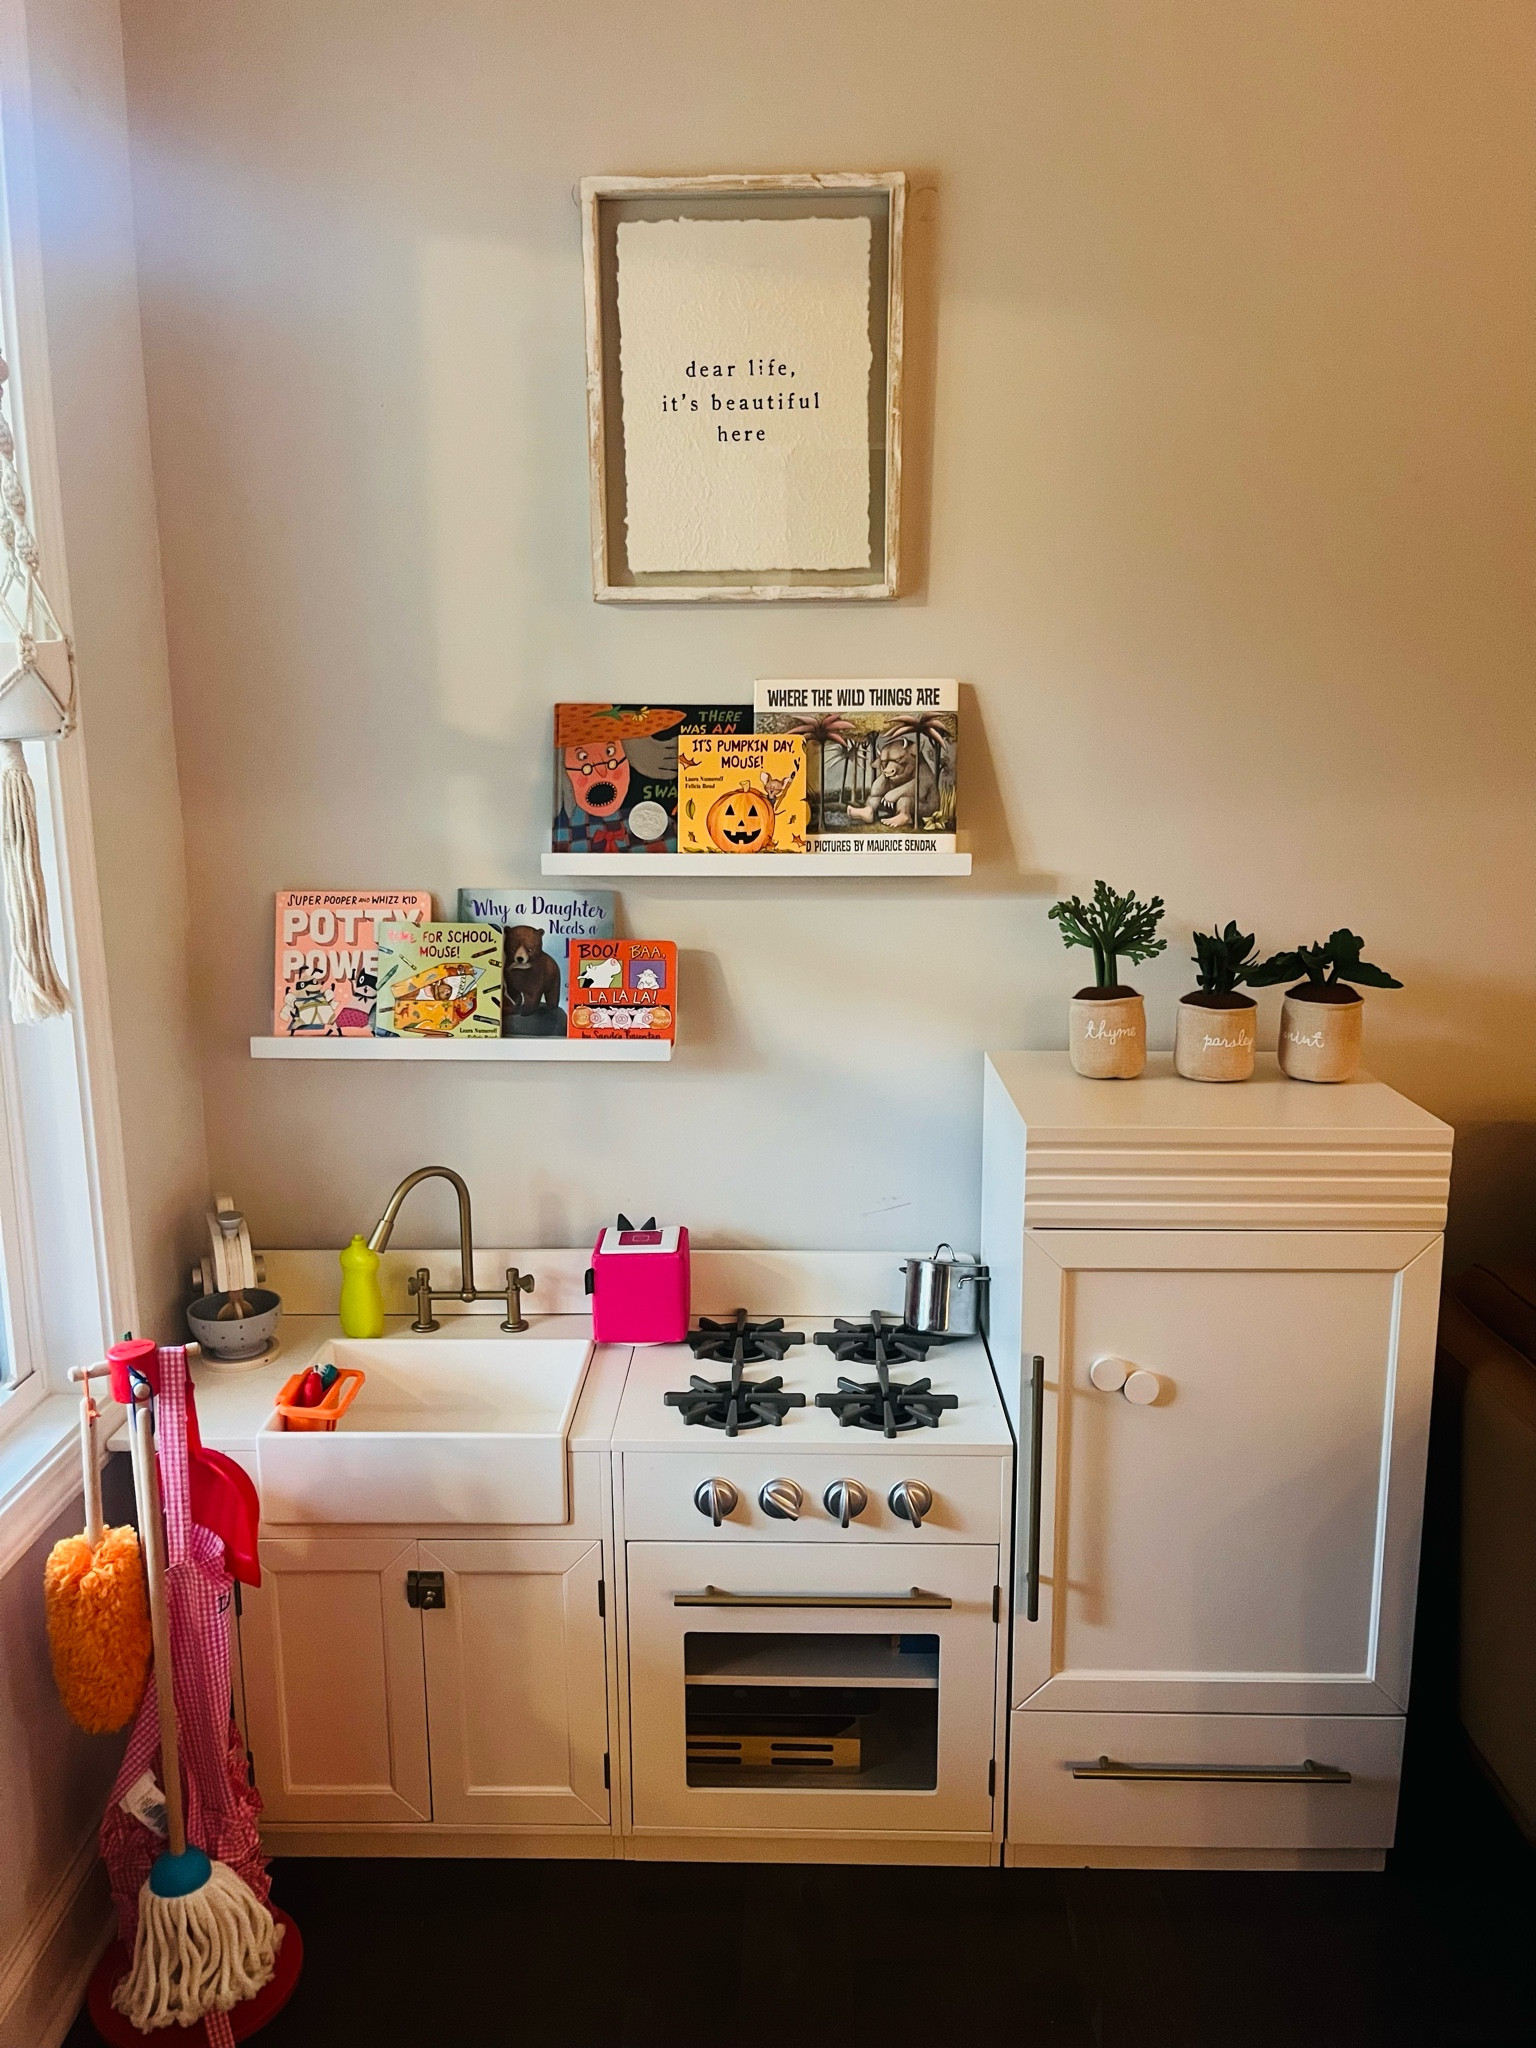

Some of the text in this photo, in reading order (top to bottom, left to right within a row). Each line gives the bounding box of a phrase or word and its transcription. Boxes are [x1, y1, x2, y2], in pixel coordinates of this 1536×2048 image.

[685, 359, 796, 378] dear life,
[662, 392, 820, 412] it's beautiful
[717, 425, 766, 442] here
[767, 688, 941, 707] WHERE THE WILD THINGS ARE
[698, 710, 743, 722] THERE
[680, 723, 737, 735] WAS AN
[692, 738, 796, 754] IT'S PUMPKIN DAY,
[721, 755, 765, 769] MOUSE!
[814, 840, 851, 852] PICTURES
[854, 840, 864, 852] BY
[867, 839, 902, 852] MAURICE
[905, 839, 937, 852] SENDAK
[287, 894, 322, 906] SUPER
[324, 895, 357, 905] POOPER
[371, 895, 399, 905] WHIZZ
[402, 895, 418, 905] KID
[471, 895, 607, 924] Why a Daughter
[549, 919, 599, 935] Needs a
[422, 931, 443, 943] FOR
[419, 946, 460, 959] MOUSE!
[577, 943, 619, 959] BOO!
[629, 944, 667, 959] BAA,
[588, 990, 657, 1005] LA LA LA!
[1084, 1020, 1137, 1046] thyme
[1202, 1028, 1254, 1052] parsley
